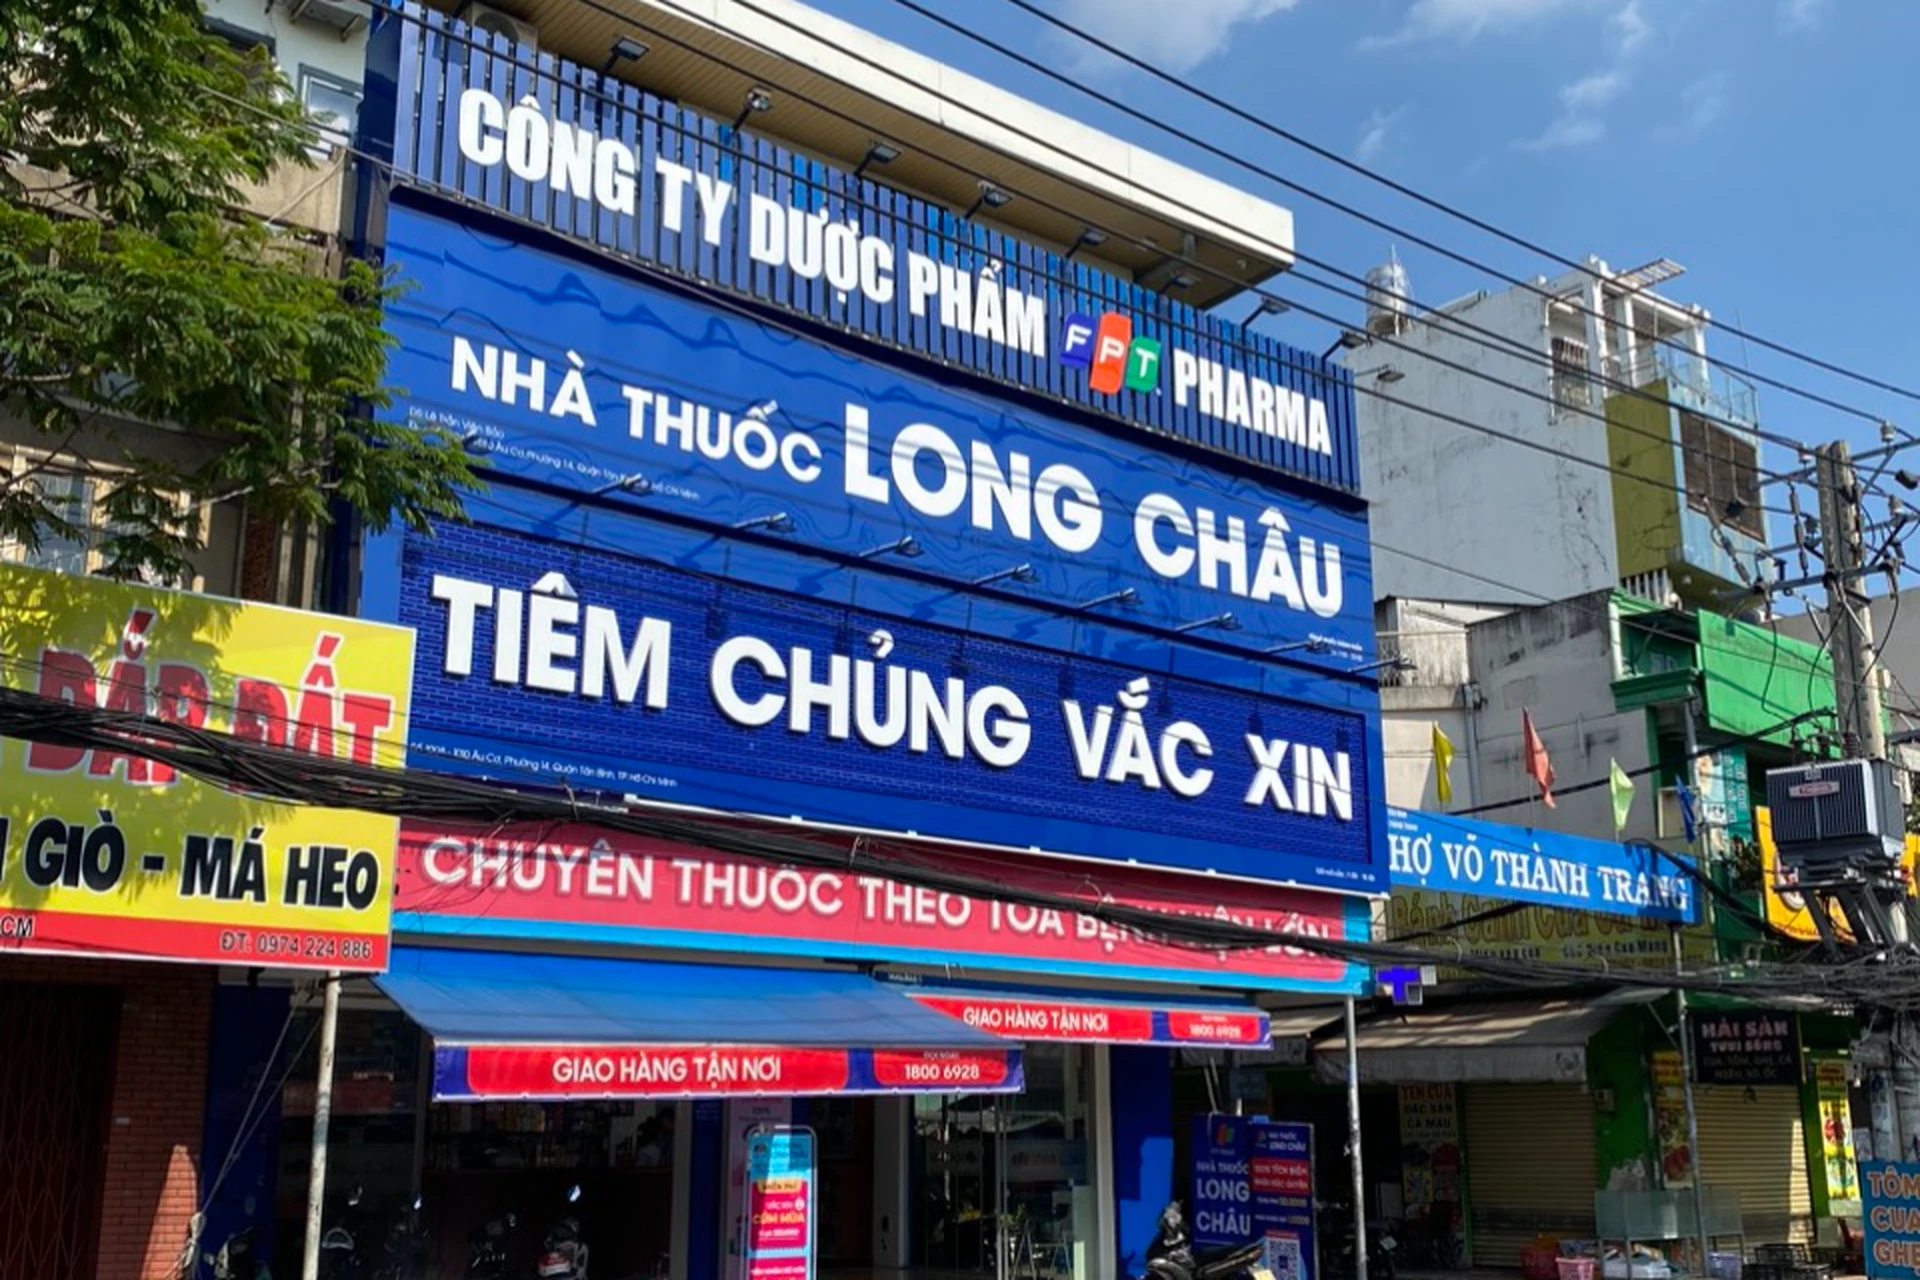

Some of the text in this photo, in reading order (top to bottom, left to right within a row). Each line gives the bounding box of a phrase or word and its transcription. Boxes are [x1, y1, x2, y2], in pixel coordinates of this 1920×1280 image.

[458, 88, 1333, 456] CÔNG TY DƯỢC PHẨM FPT PHARMA
[451, 336, 1343, 618] NHÀ THUỐC LONG CHÂU
[432, 571, 1353, 821] TIÊM CHỦNG VẮC XIN
[25, 810, 125, 892] GIÒ
[180, 828, 267, 903] MÁ
[283, 844, 379, 910] HEO
[1441, 832, 1483, 882] VÕ
[1490, 843, 1589, 897] THÀNH
[1597, 865, 1688, 911] TRANG
[422, 837, 653, 900] CHUYÊN
[859, 877, 970, 926] THEO
[990, 897, 1064, 935] TOA
[257, 933, 300, 954] 0974
[305, 936, 335, 955] 224
[341, 938, 372, 959] 886
[963, 1007, 1001, 1029] GIAO
[1004, 1006, 1048, 1030] HÀNG
[1050, 1006, 1080, 1036] TẬN
[1082, 1011, 1109, 1032] NƠI
[1701, 1015, 1789, 1038] HẢI SẢN
[552, 1051, 980, 1089] GIAO HÀNG TẬN NƠI 1800 6928
[1196, 1178, 1250, 1203] LONG
[1867, 1165, 1920, 1200] TÔM
[1196, 1207, 1250, 1236] CHÂU
